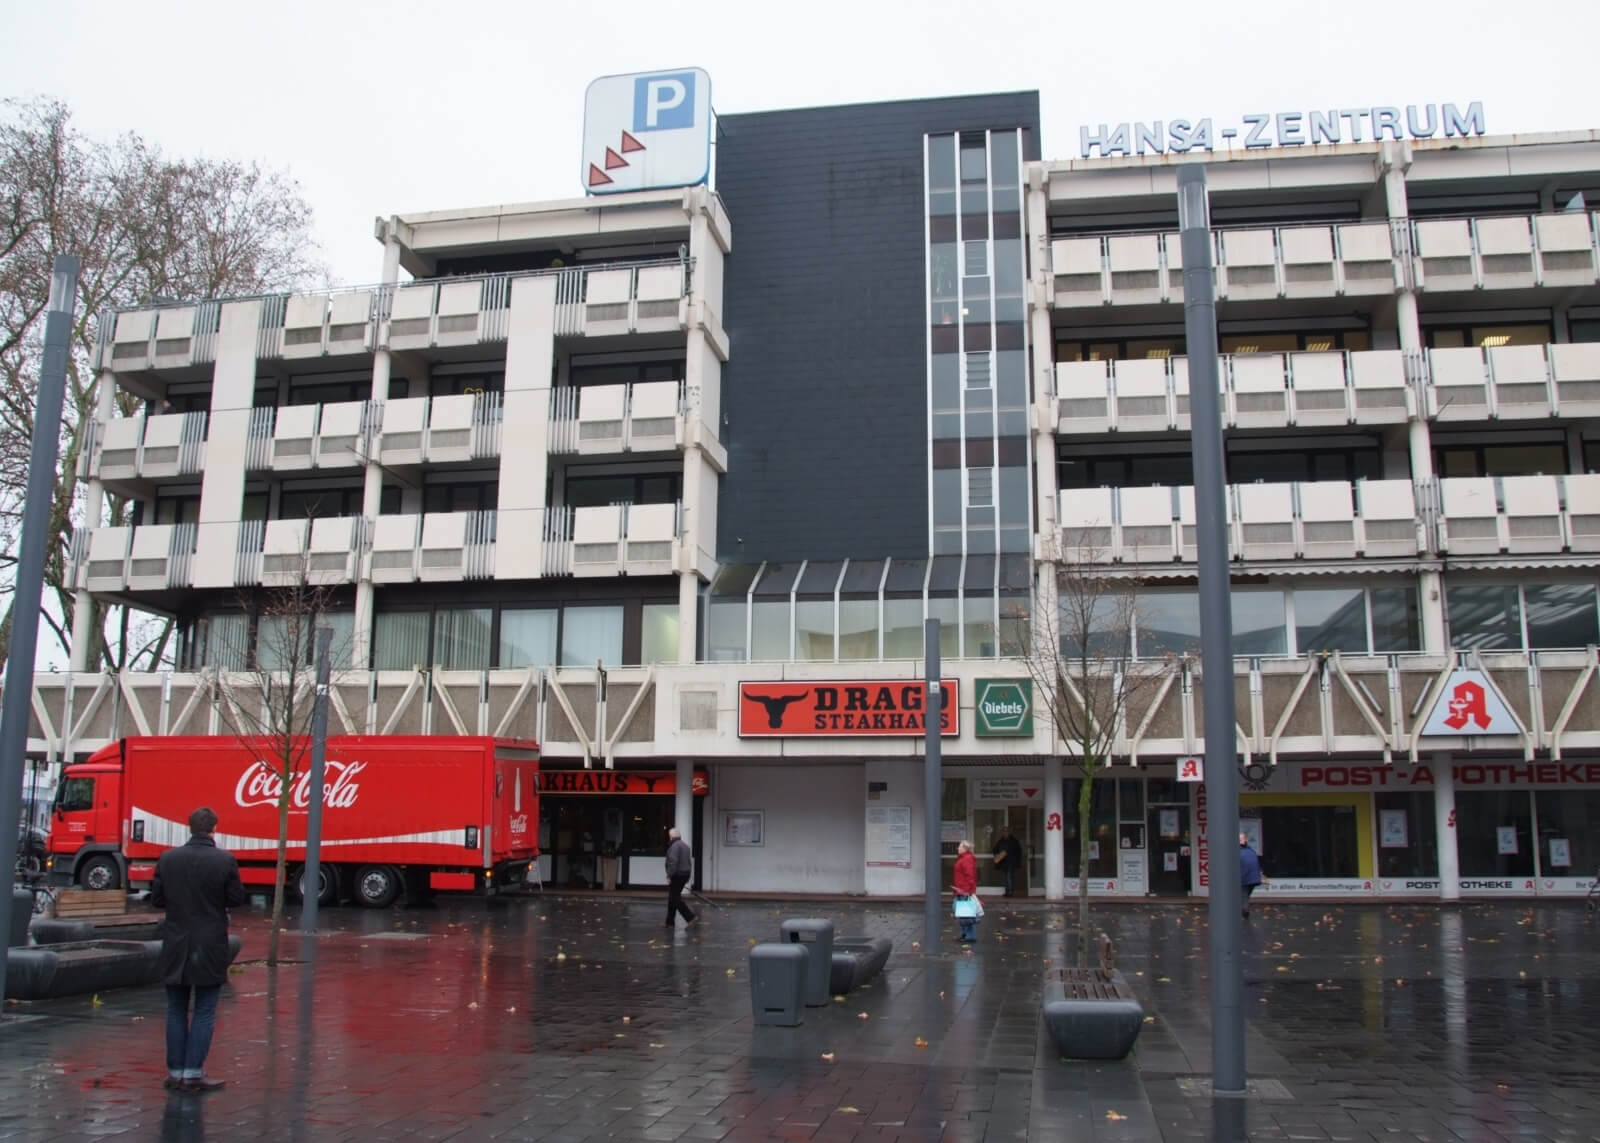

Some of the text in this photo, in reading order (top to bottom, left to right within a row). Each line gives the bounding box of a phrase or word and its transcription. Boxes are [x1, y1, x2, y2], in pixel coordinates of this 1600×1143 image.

[646, 79, 686, 127] P
[1079, 101, 1486, 158] HANSA-ZENTRUM
[1302, 763, 1600, 787] POST-AOTHEKE
[1405, 881, 1513, 889] POSTOTHEKE
